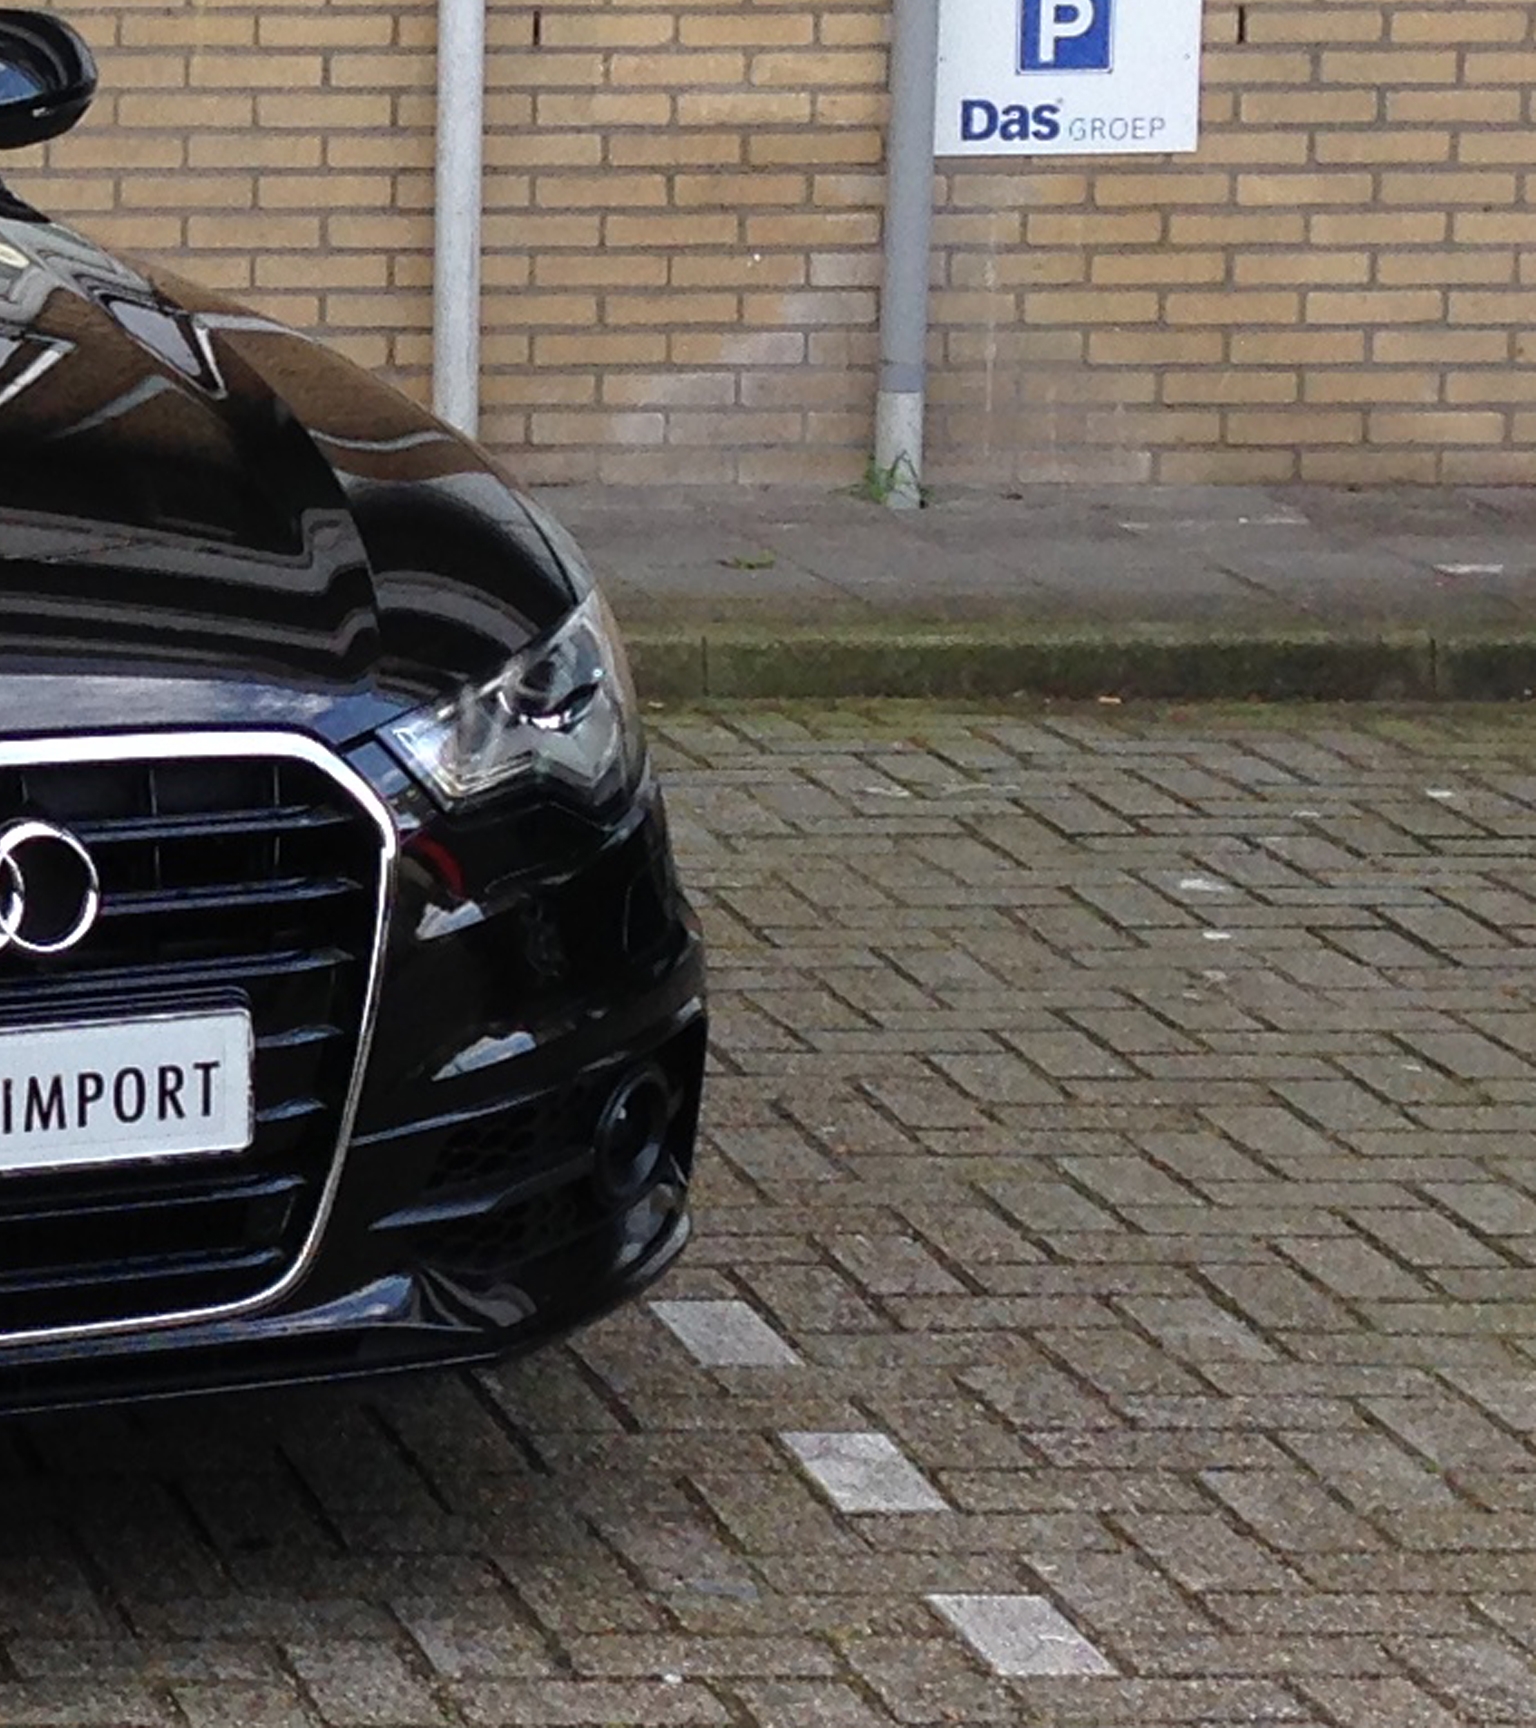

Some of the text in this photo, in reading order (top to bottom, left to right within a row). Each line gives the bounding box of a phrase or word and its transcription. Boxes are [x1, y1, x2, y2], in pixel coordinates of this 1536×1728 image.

[960, 99, 1166, 142] Das GROEP
[2, 1060, 221, 1134] IMPORT
